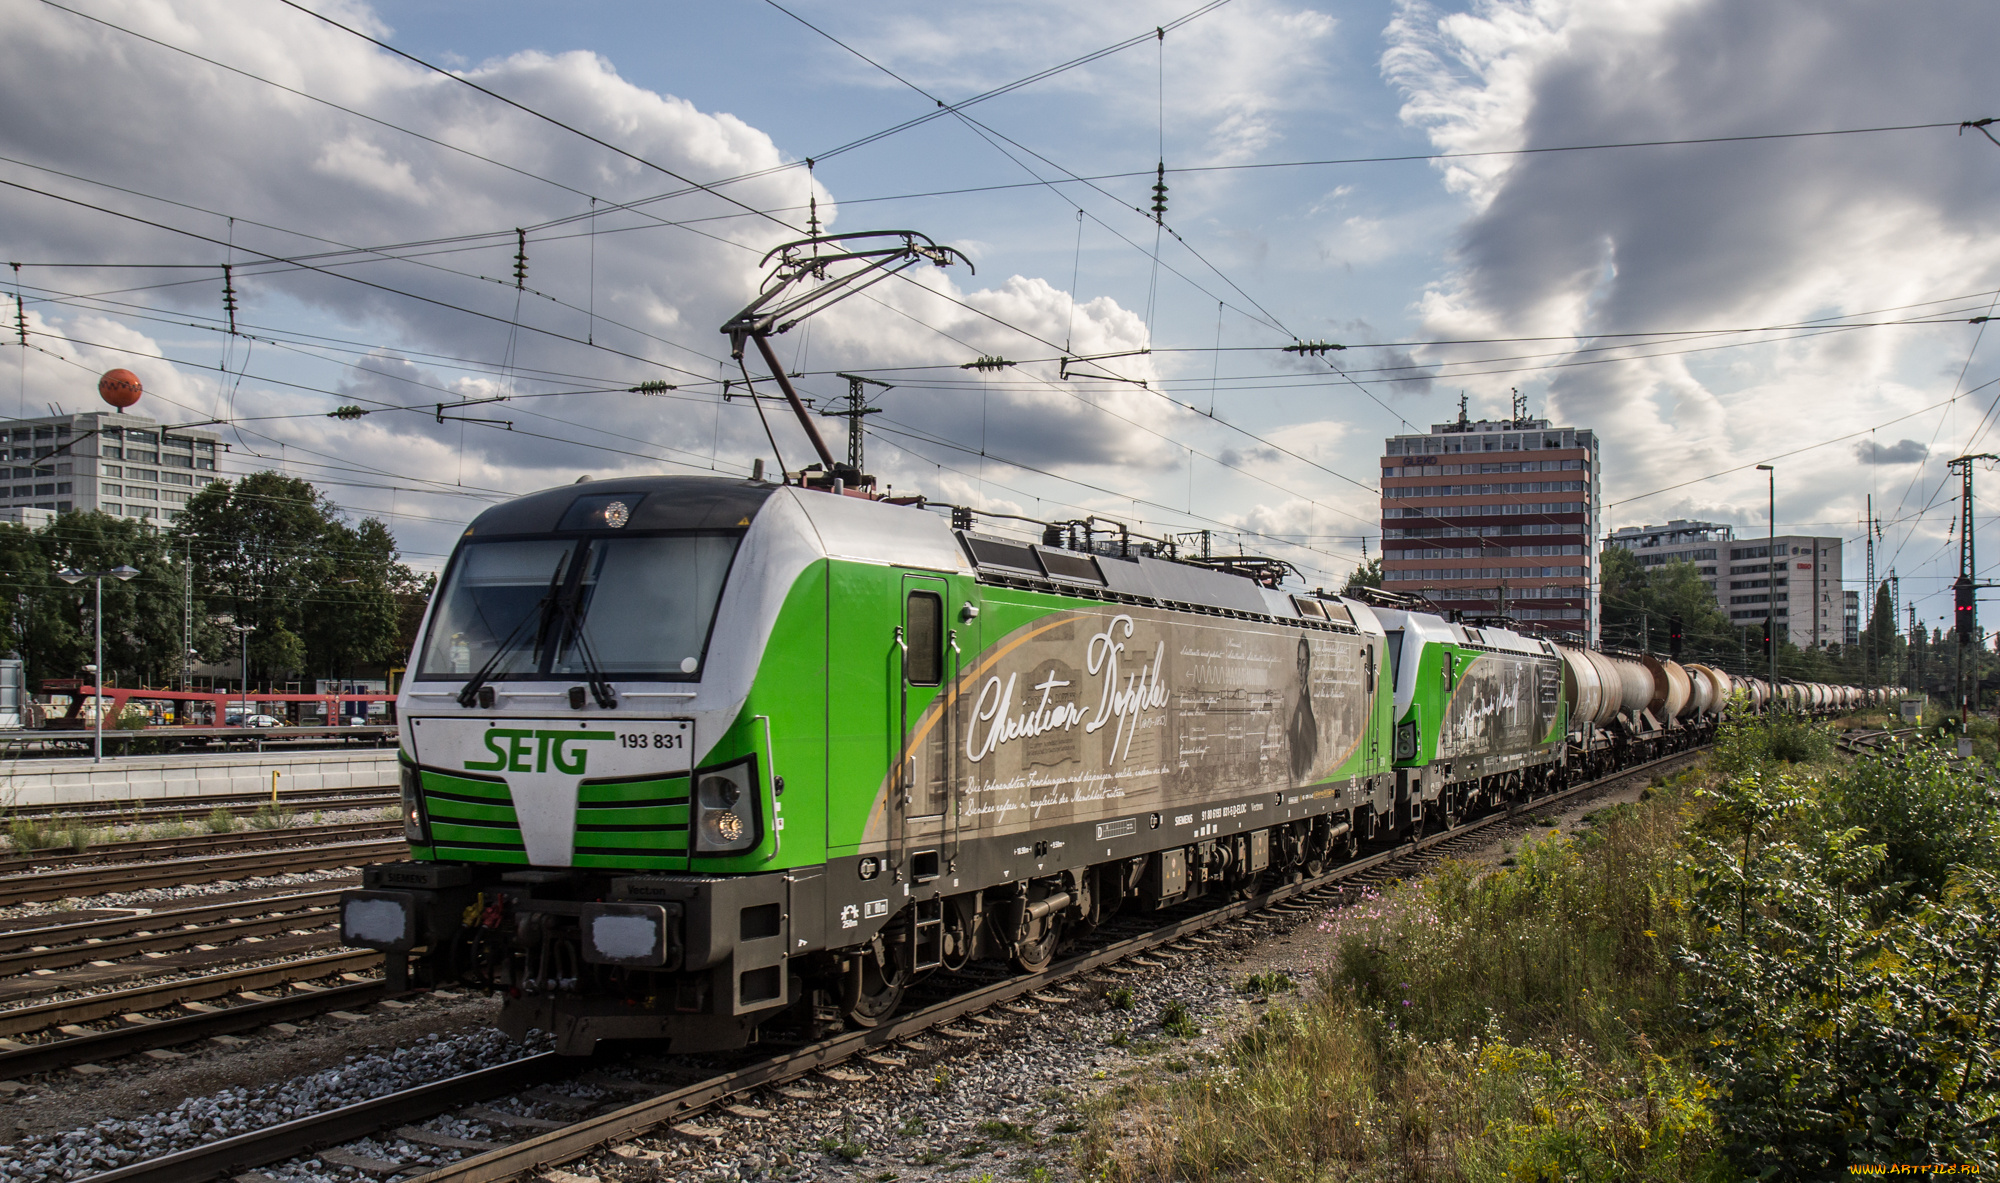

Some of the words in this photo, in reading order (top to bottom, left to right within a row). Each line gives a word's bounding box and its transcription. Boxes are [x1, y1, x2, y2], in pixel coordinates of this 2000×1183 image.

[966, 670, 1089, 762] Christian
[1086, 614, 1170, 766] Doppler
[464, 728, 616, 775] SETG
[619, 734, 648, 748] 193
[653, 734, 683, 749] 831
[965, 776, 982, 794] Die
[1175, 814, 1193, 826] SIEMENS
[388, 872, 428, 884] SIEMENS
[627, 884, 666, 895] Vectron
